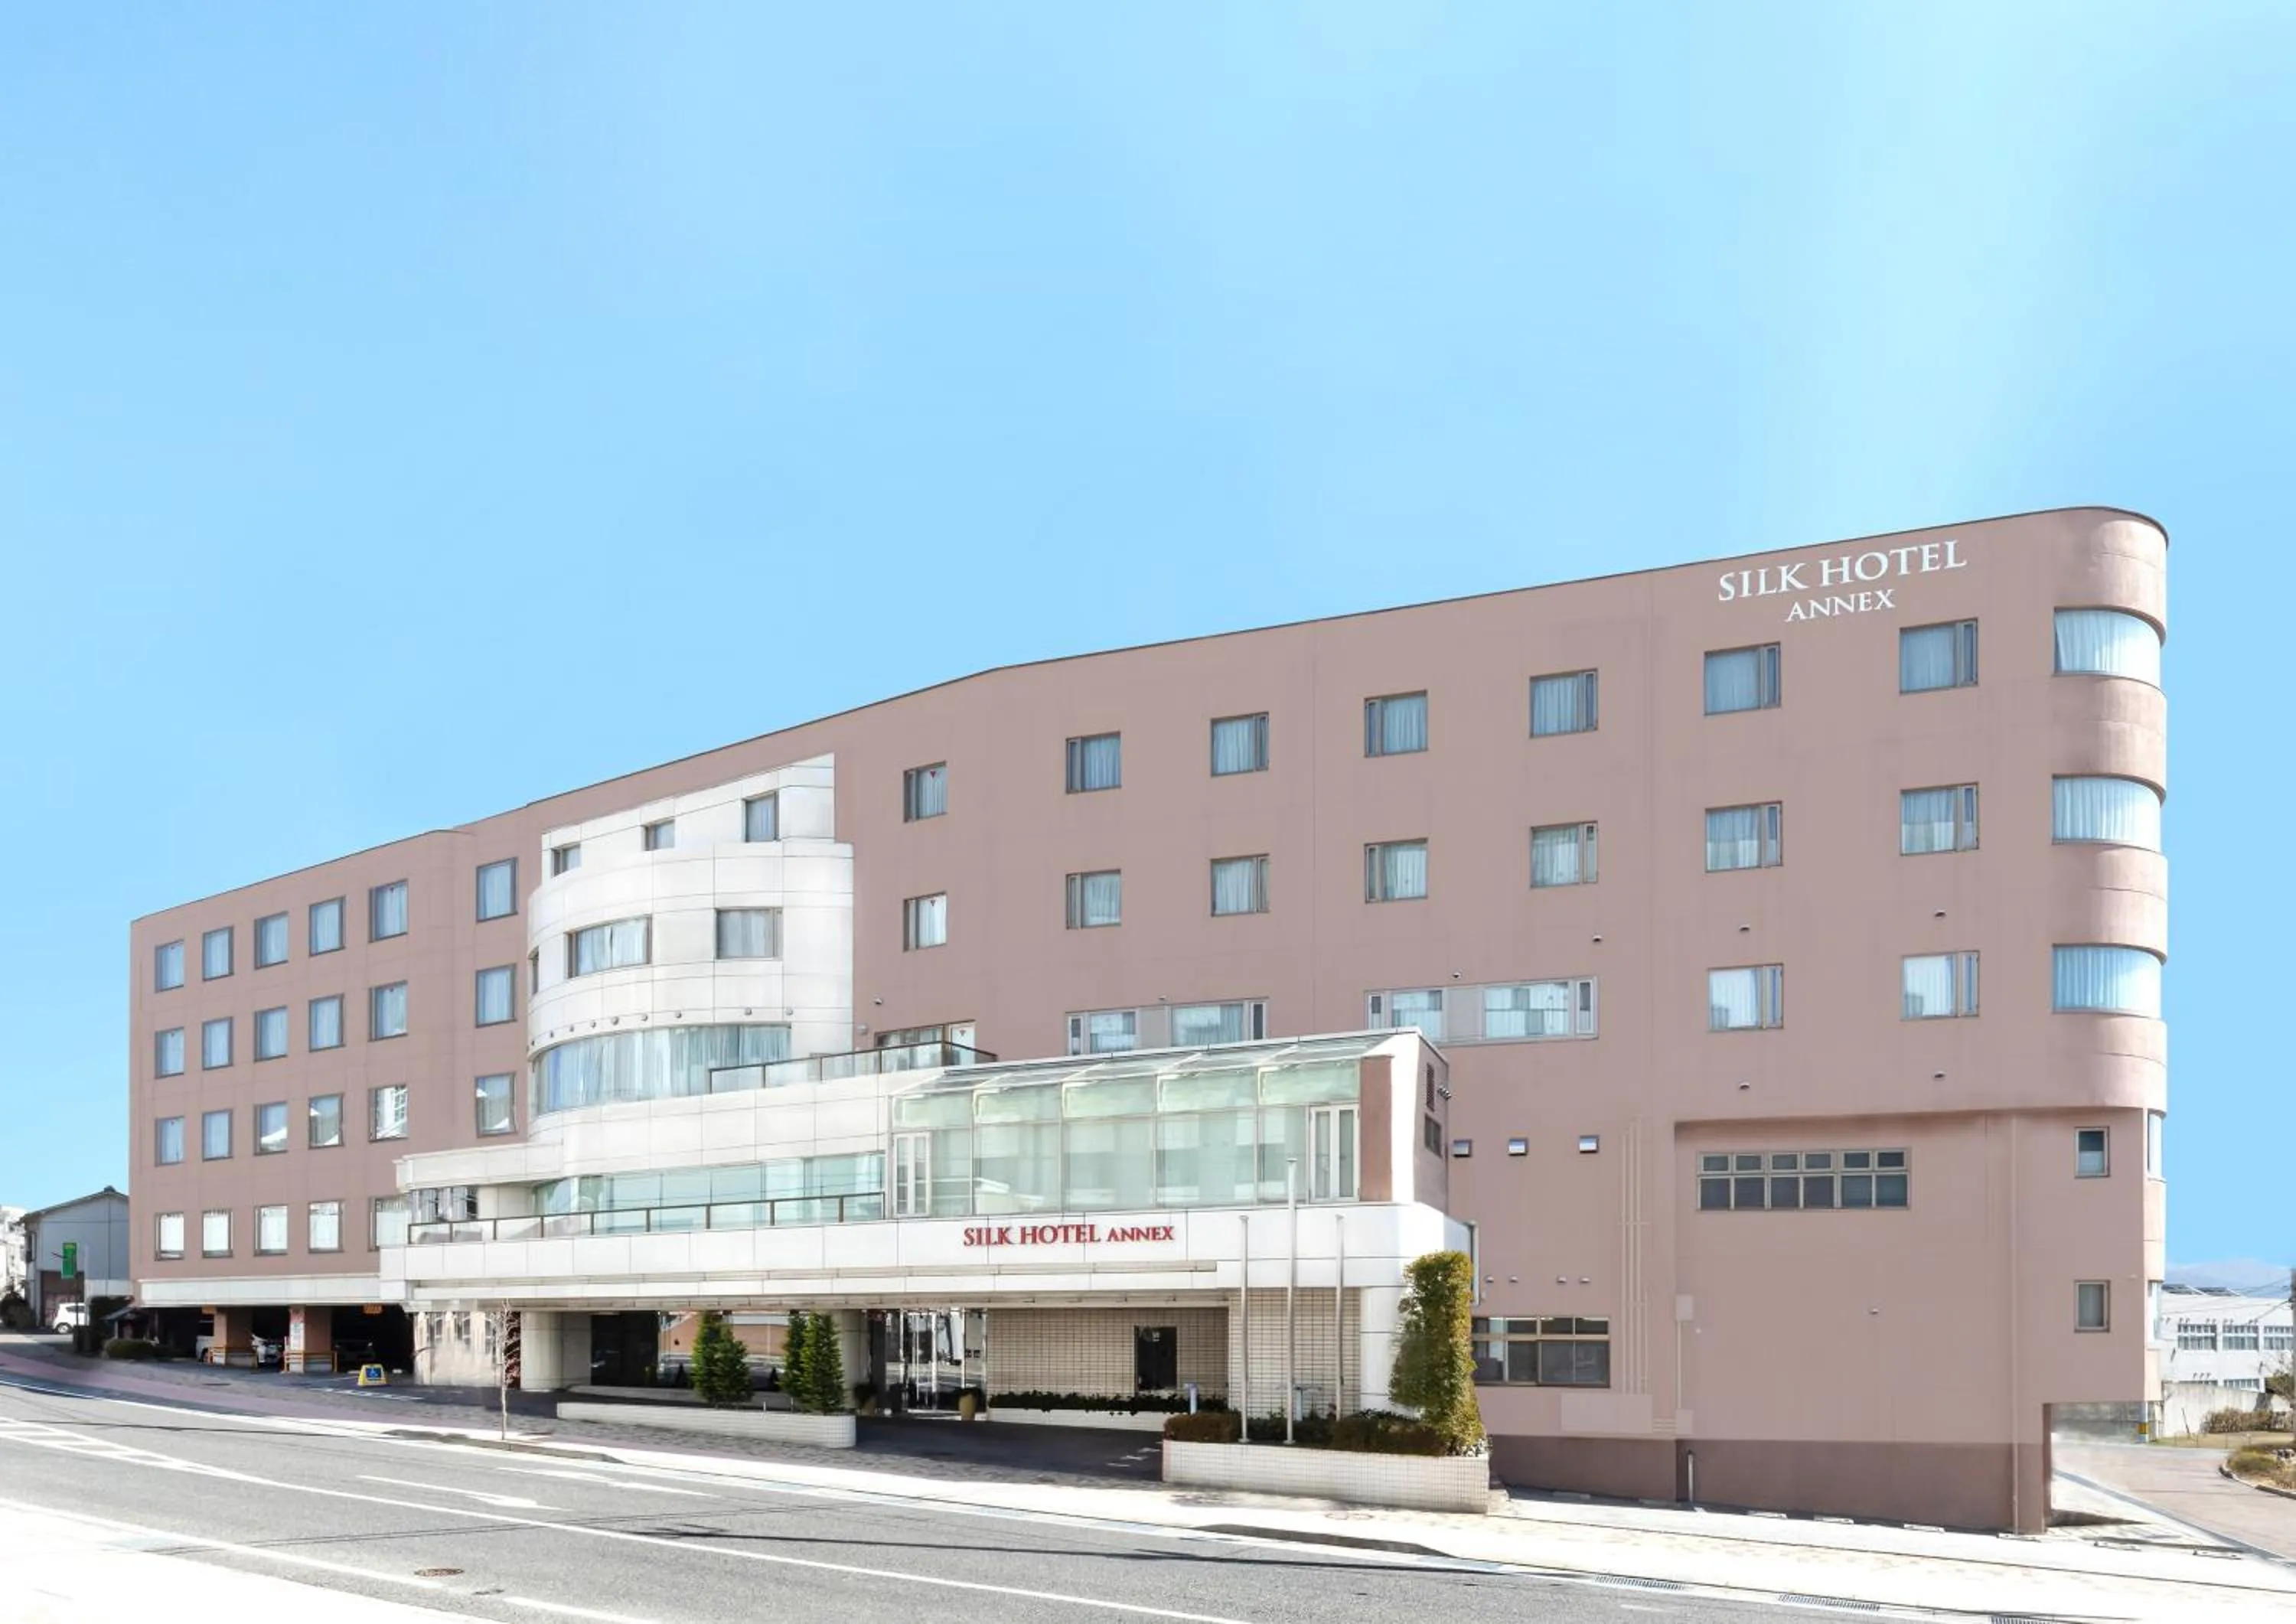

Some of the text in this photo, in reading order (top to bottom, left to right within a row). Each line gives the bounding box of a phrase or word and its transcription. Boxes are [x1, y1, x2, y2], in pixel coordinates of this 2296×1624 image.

[1718, 540, 1968, 601] SILK HOTEL
[1784, 589, 1896, 622] ANNEX
[964, 1225, 1174, 1246] SILK HOTEL ANNEX
